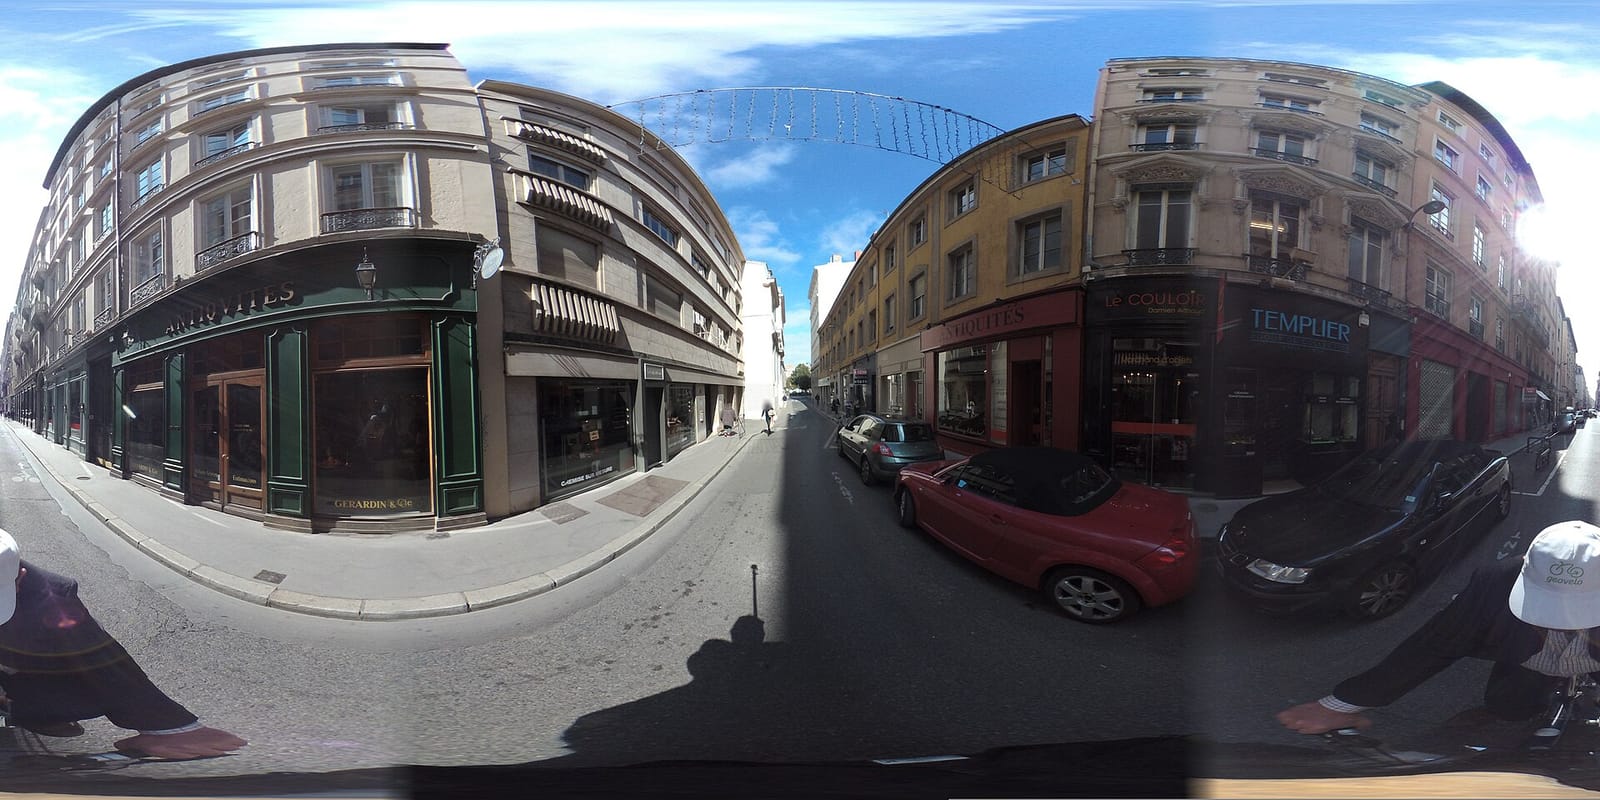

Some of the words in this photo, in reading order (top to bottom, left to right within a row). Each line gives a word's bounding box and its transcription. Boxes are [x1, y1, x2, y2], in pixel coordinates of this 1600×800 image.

[1105, 294, 1122, 308] Le
[1251, 308, 1351, 343] TEMPLIER
[334, 499, 387, 510] GERARDIN
[1543, 575, 1584, 586] geovelo
